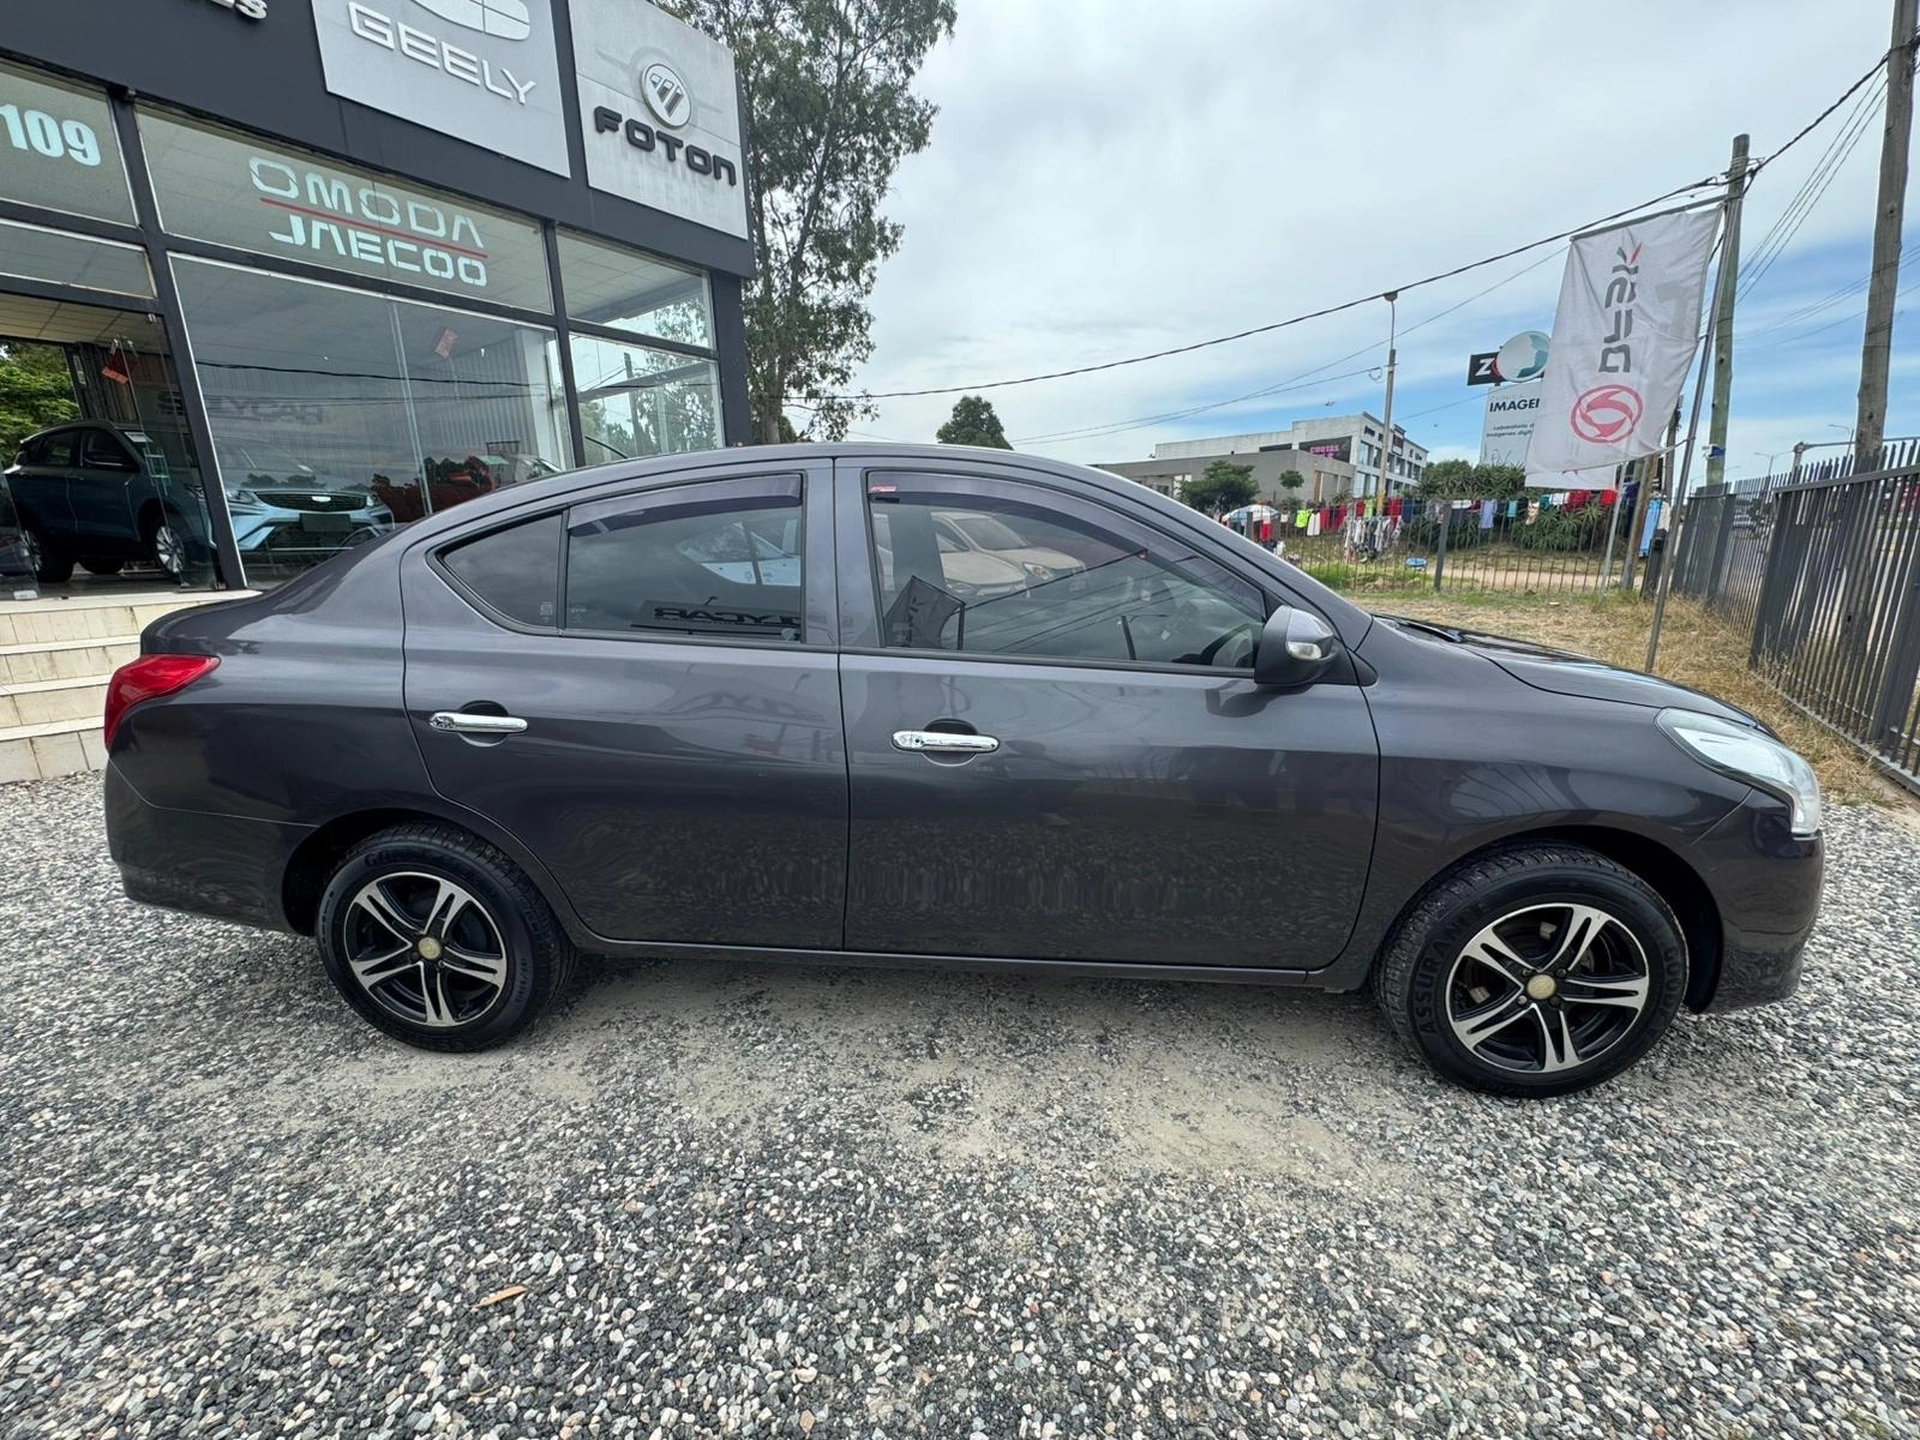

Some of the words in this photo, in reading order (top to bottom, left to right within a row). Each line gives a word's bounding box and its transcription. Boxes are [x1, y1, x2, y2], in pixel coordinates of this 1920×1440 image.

[347, 1, 536, 105] GEELY
[0, 104, 101, 166] 109
[593, 105, 737, 186] FOTON
[248, 157, 485, 249] OMODA
[268, 214, 488, 287] JAECOO
[1417, 902, 1484, 1033] ASSURAN
